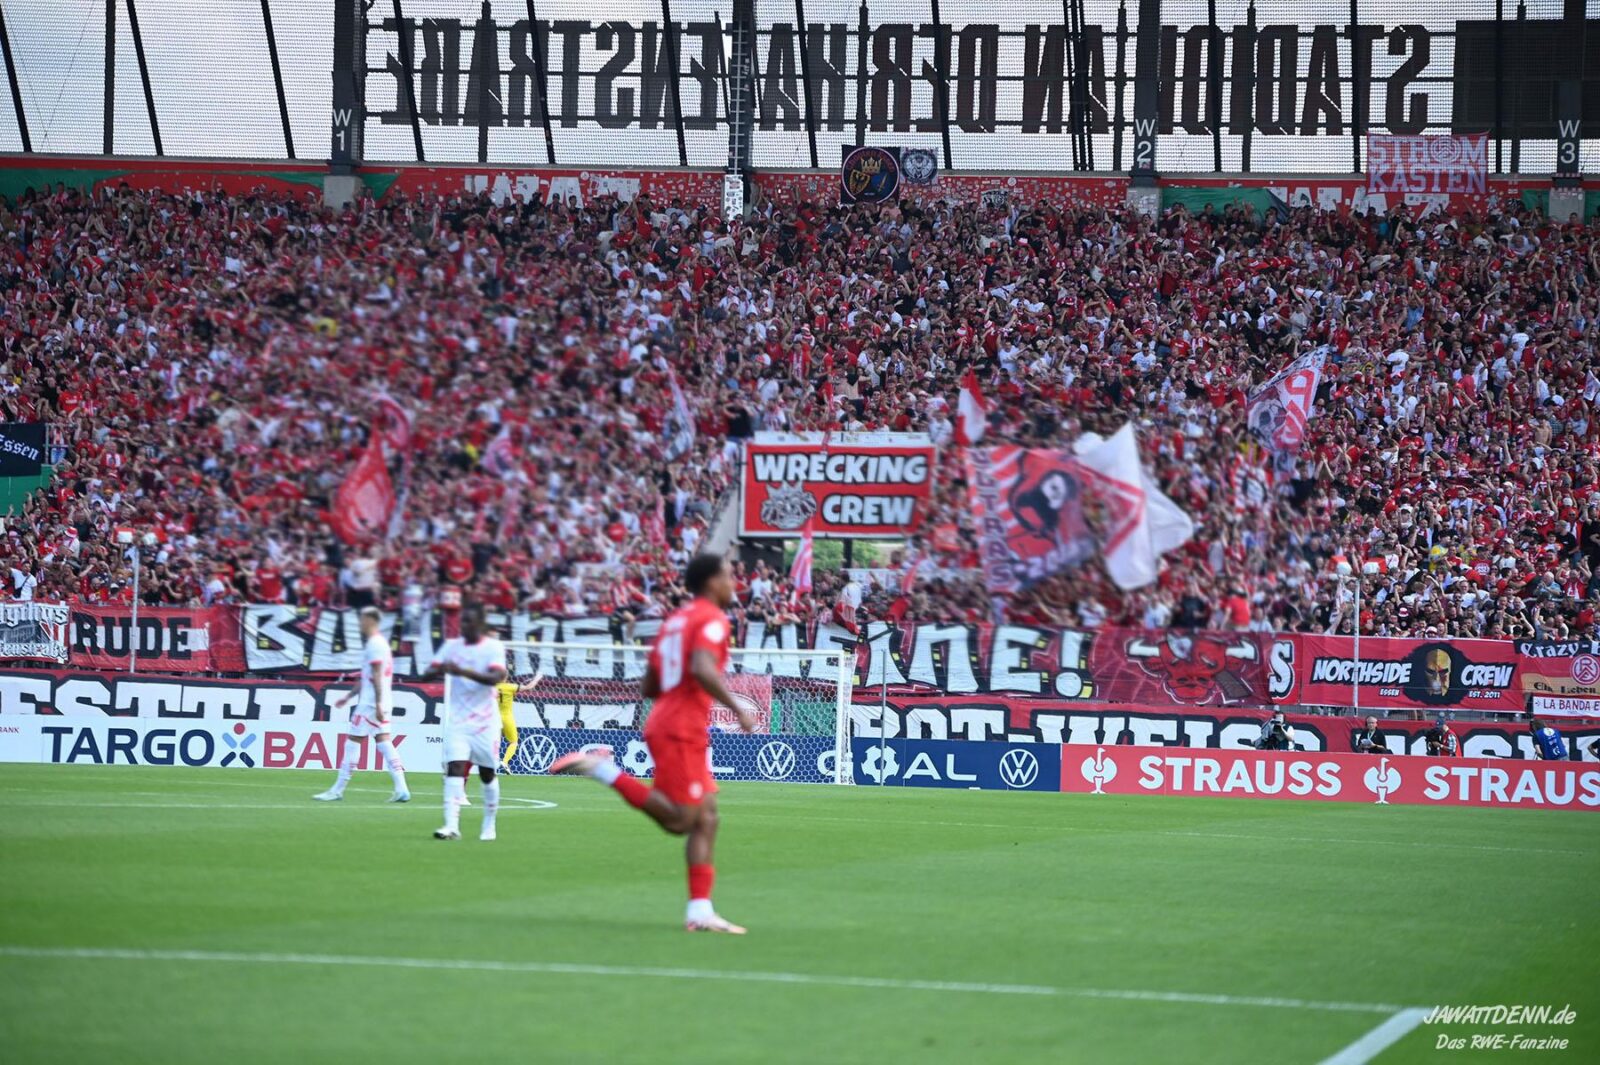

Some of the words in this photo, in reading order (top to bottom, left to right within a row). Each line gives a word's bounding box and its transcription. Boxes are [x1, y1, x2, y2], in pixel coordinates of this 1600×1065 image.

[333, 109, 352, 127] W
[1135, 119, 1156, 137] W
[1559, 120, 1580, 138] W
[336, 130, 345, 151] 1
[1137, 141, 1152, 163] 2
[1560, 142, 1576, 164] 3
[1368, 163, 1487, 193] KASTEN
[753, 453, 929, 484] WRECKING
[822, 494, 915, 526] CREW
[73, 611, 192, 661] RUDE
[1312, 659, 1412, 684] NORTHSIDE
[1461, 664, 1513, 687] CREW
[1379, 688, 1400, 697] ESSEN
[1484, 691, 1501, 699] 2011
[1543, 699, 1556, 710] LA
[1559, 700, 1591, 711] BANDA
[41, 727, 215, 767] TARGO
[425, 736, 443, 745] TAR
[1138, 754, 1341, 798] STRAUSS
